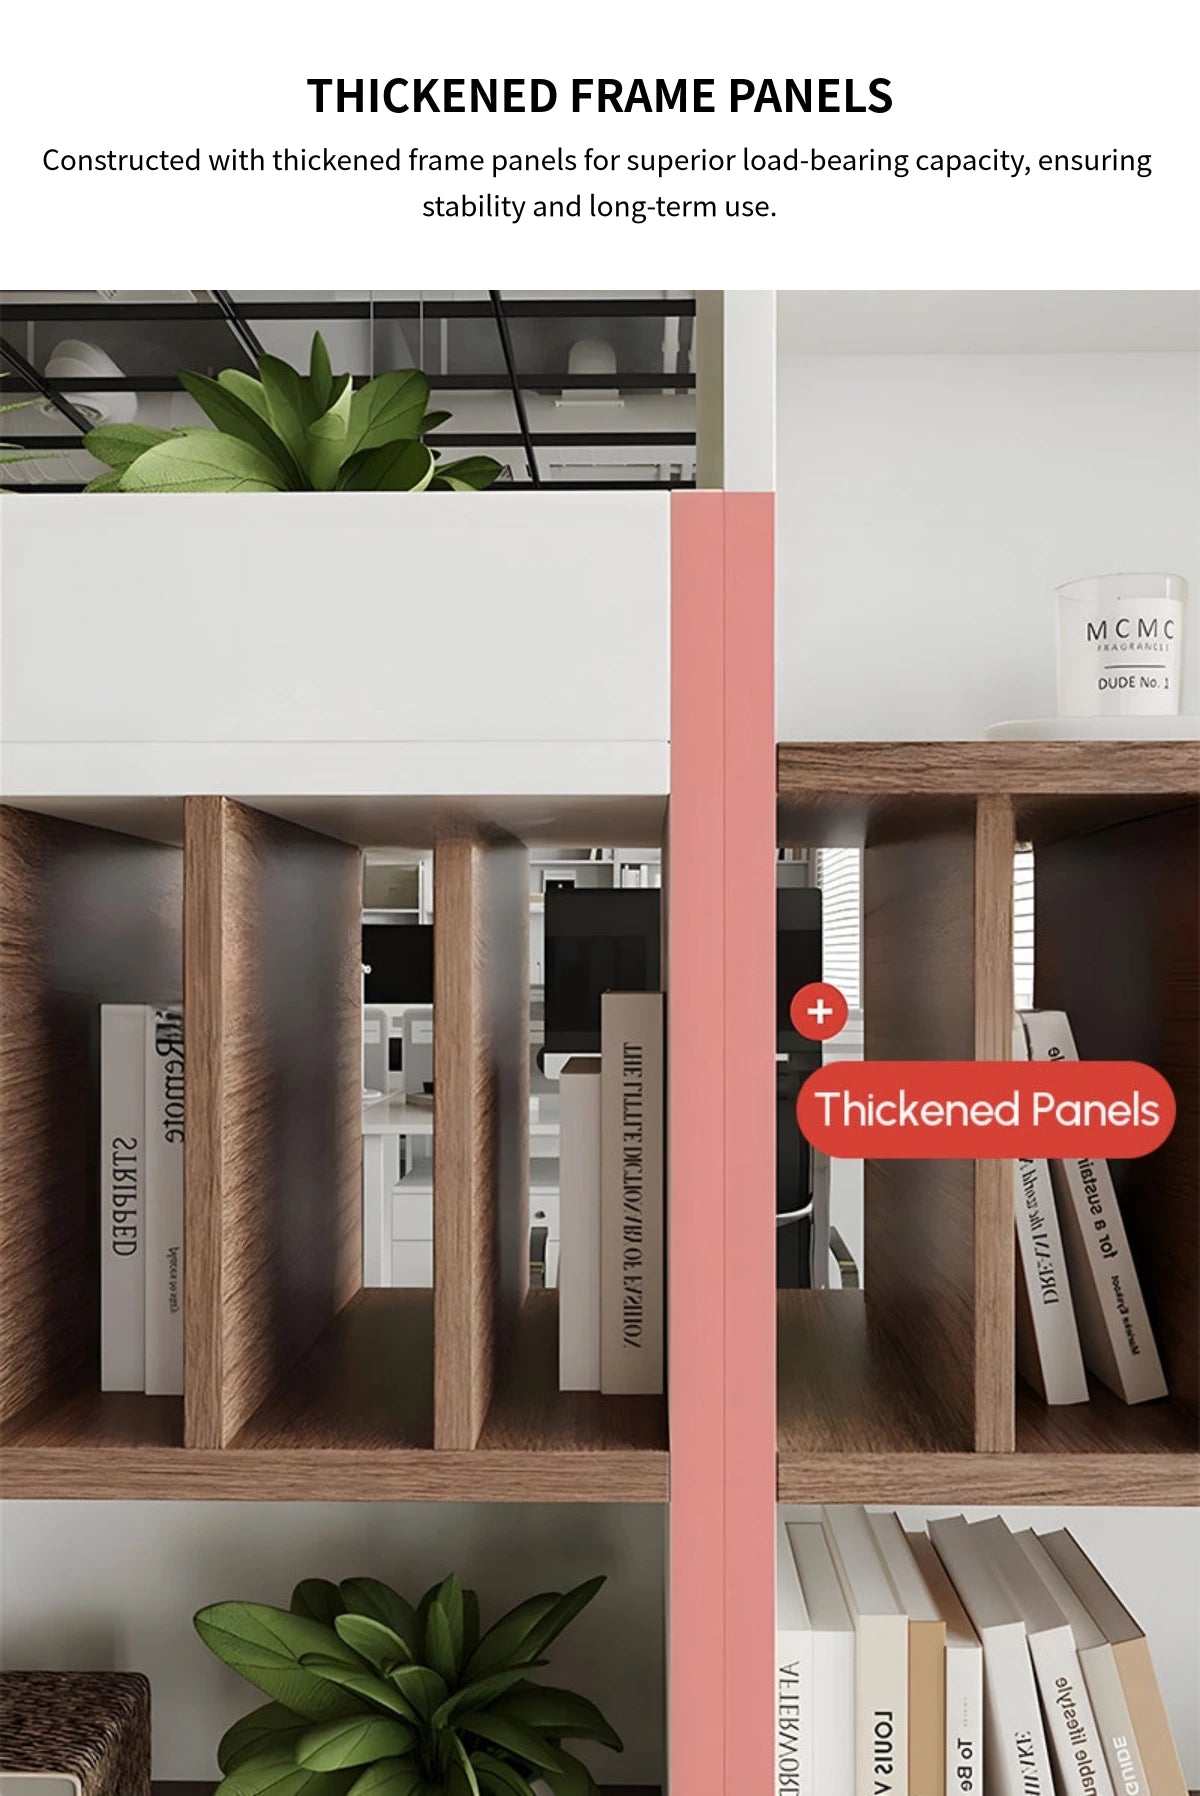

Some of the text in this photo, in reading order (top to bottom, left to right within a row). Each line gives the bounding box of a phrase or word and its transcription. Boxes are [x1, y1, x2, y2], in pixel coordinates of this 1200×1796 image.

[1086, 617, 1175, 642] MCMC
[1098, 675, 1170, 691] DUDE No. 1
